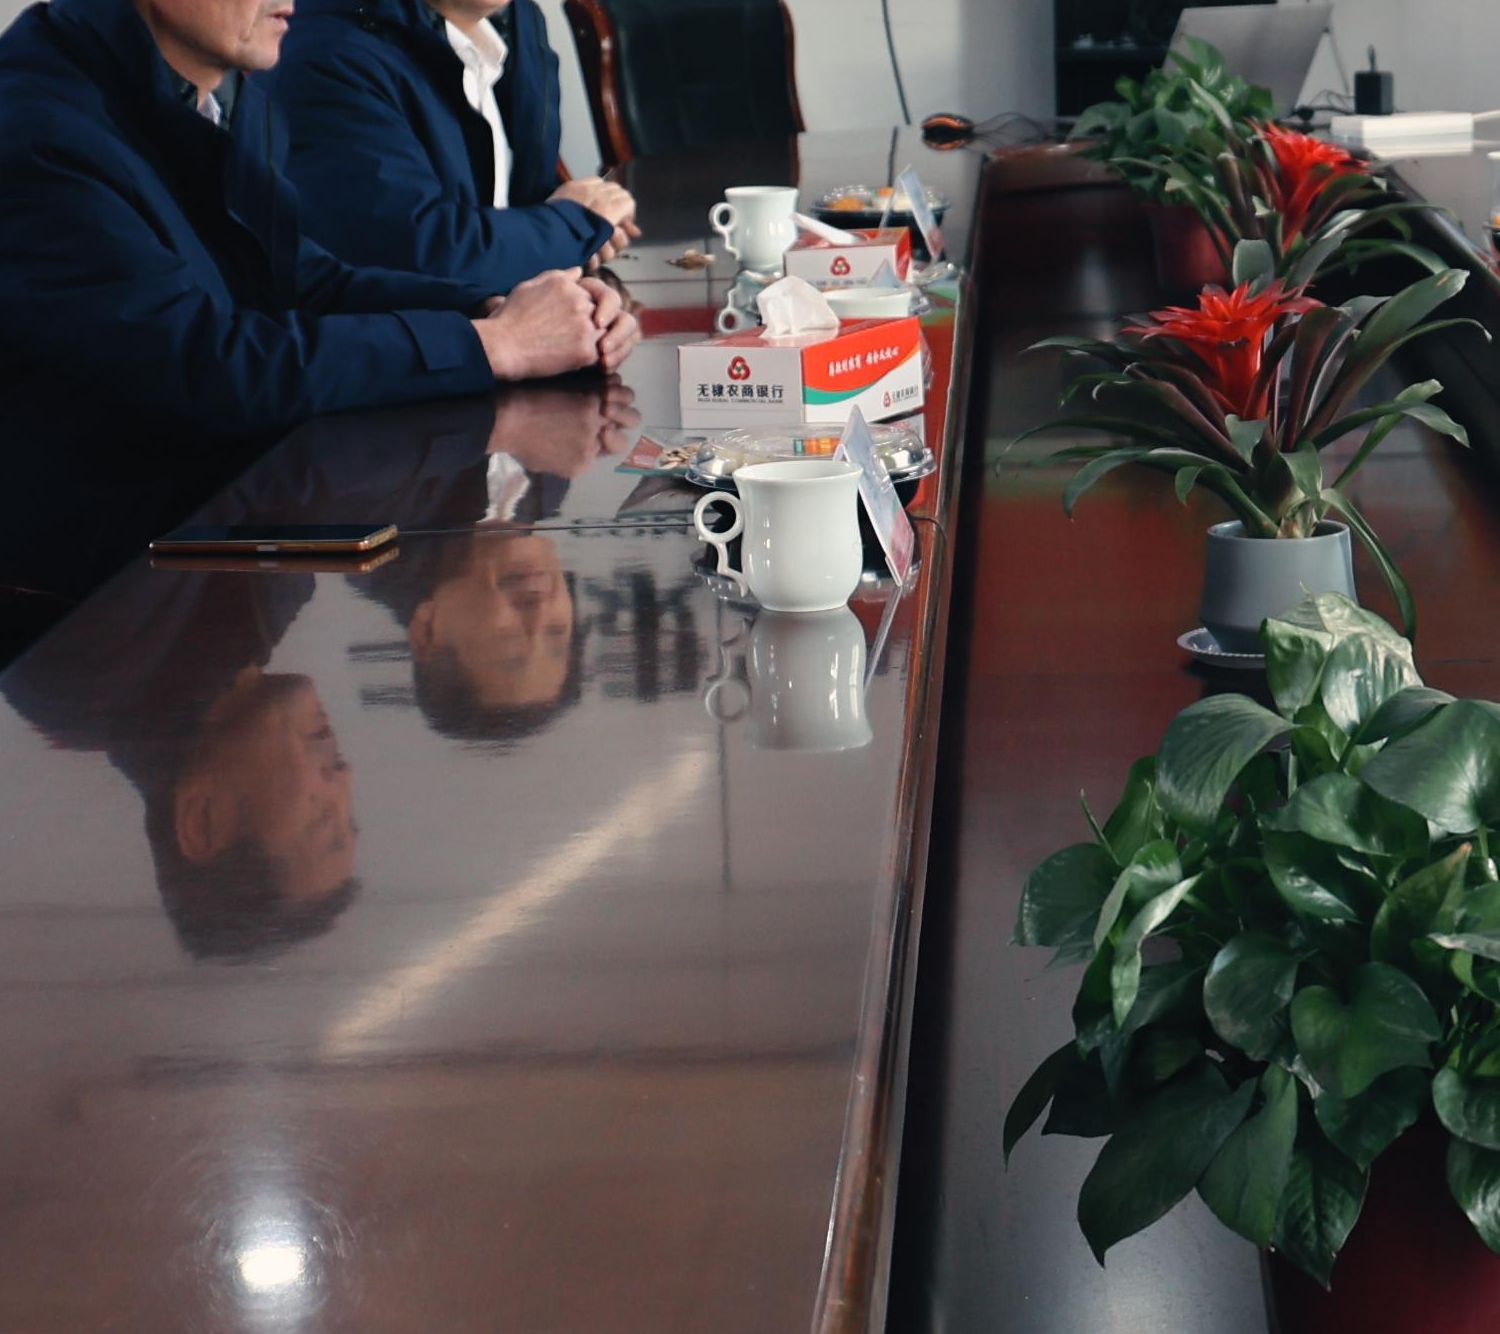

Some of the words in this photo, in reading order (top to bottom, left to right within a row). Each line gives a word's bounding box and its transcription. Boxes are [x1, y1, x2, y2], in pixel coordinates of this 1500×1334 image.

[697, 383, 783, 399] 无棣农商银行
